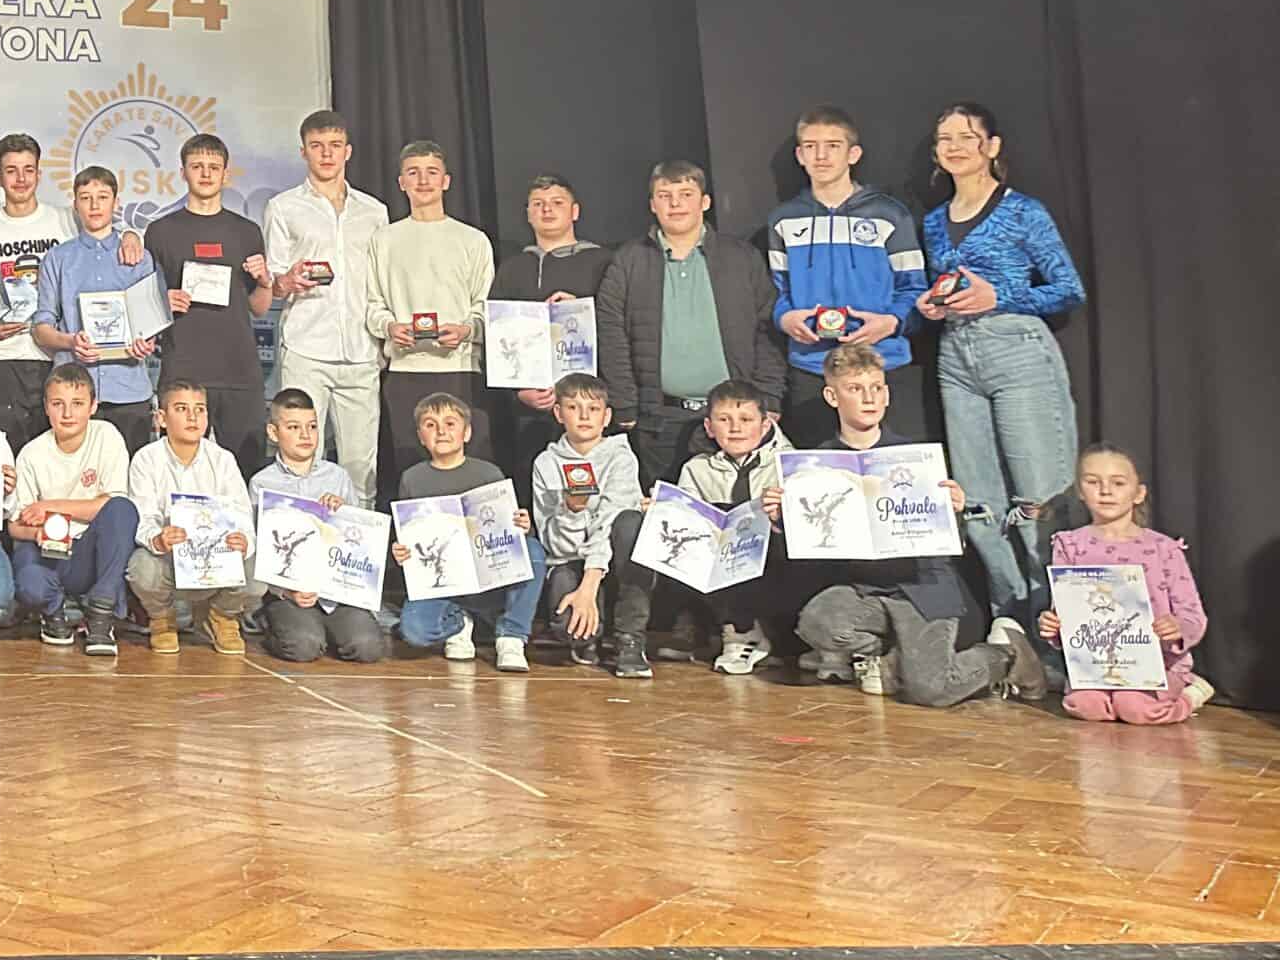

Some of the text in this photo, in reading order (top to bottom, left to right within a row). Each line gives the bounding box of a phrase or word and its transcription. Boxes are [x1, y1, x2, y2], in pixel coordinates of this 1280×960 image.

[86, 107, 146, 152] KARATE
[876, 496, 938, 522] Pohvala
[475, 529, 514, 557] Pohvala
[328, 545, 374, 573] Pohvala
[1121, 627, 1152, 645] nada
